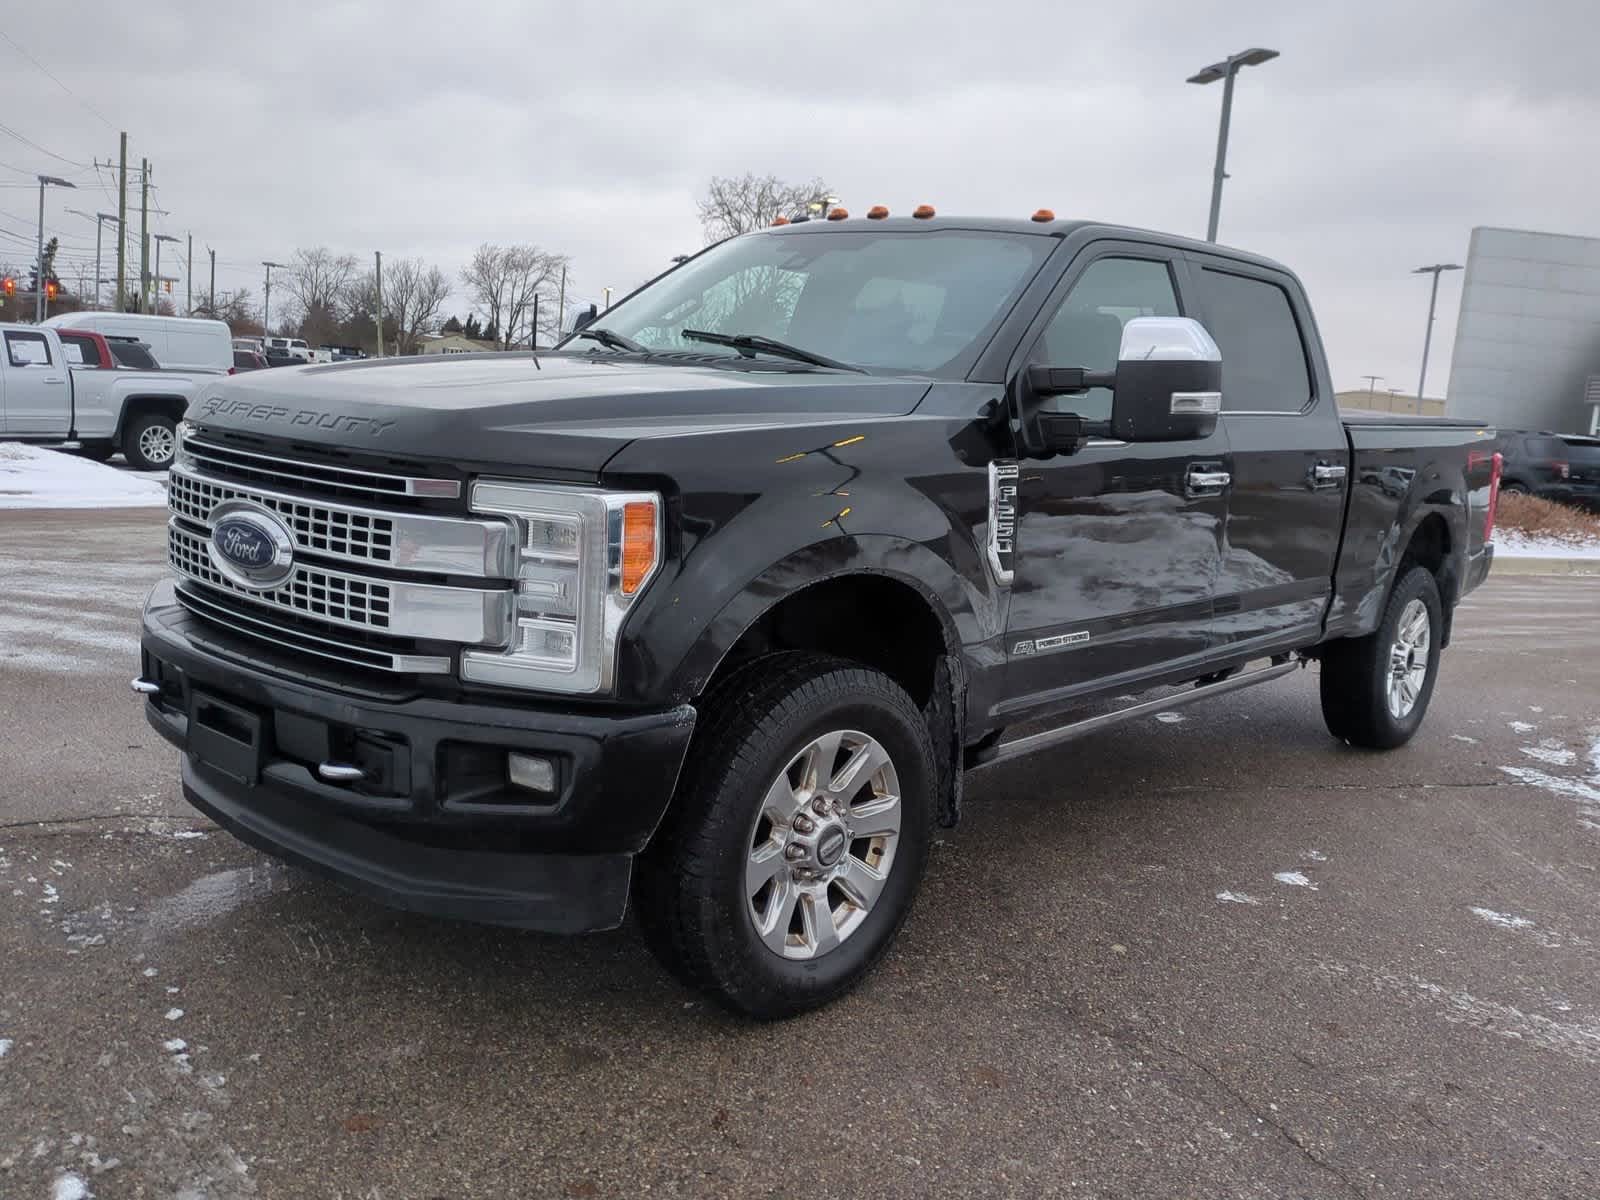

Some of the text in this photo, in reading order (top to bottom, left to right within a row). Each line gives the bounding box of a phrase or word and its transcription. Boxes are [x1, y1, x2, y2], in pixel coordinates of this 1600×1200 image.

[201, 397, 397, 437] SUPER DUTY
[224, 526, 261, 561] Ford
